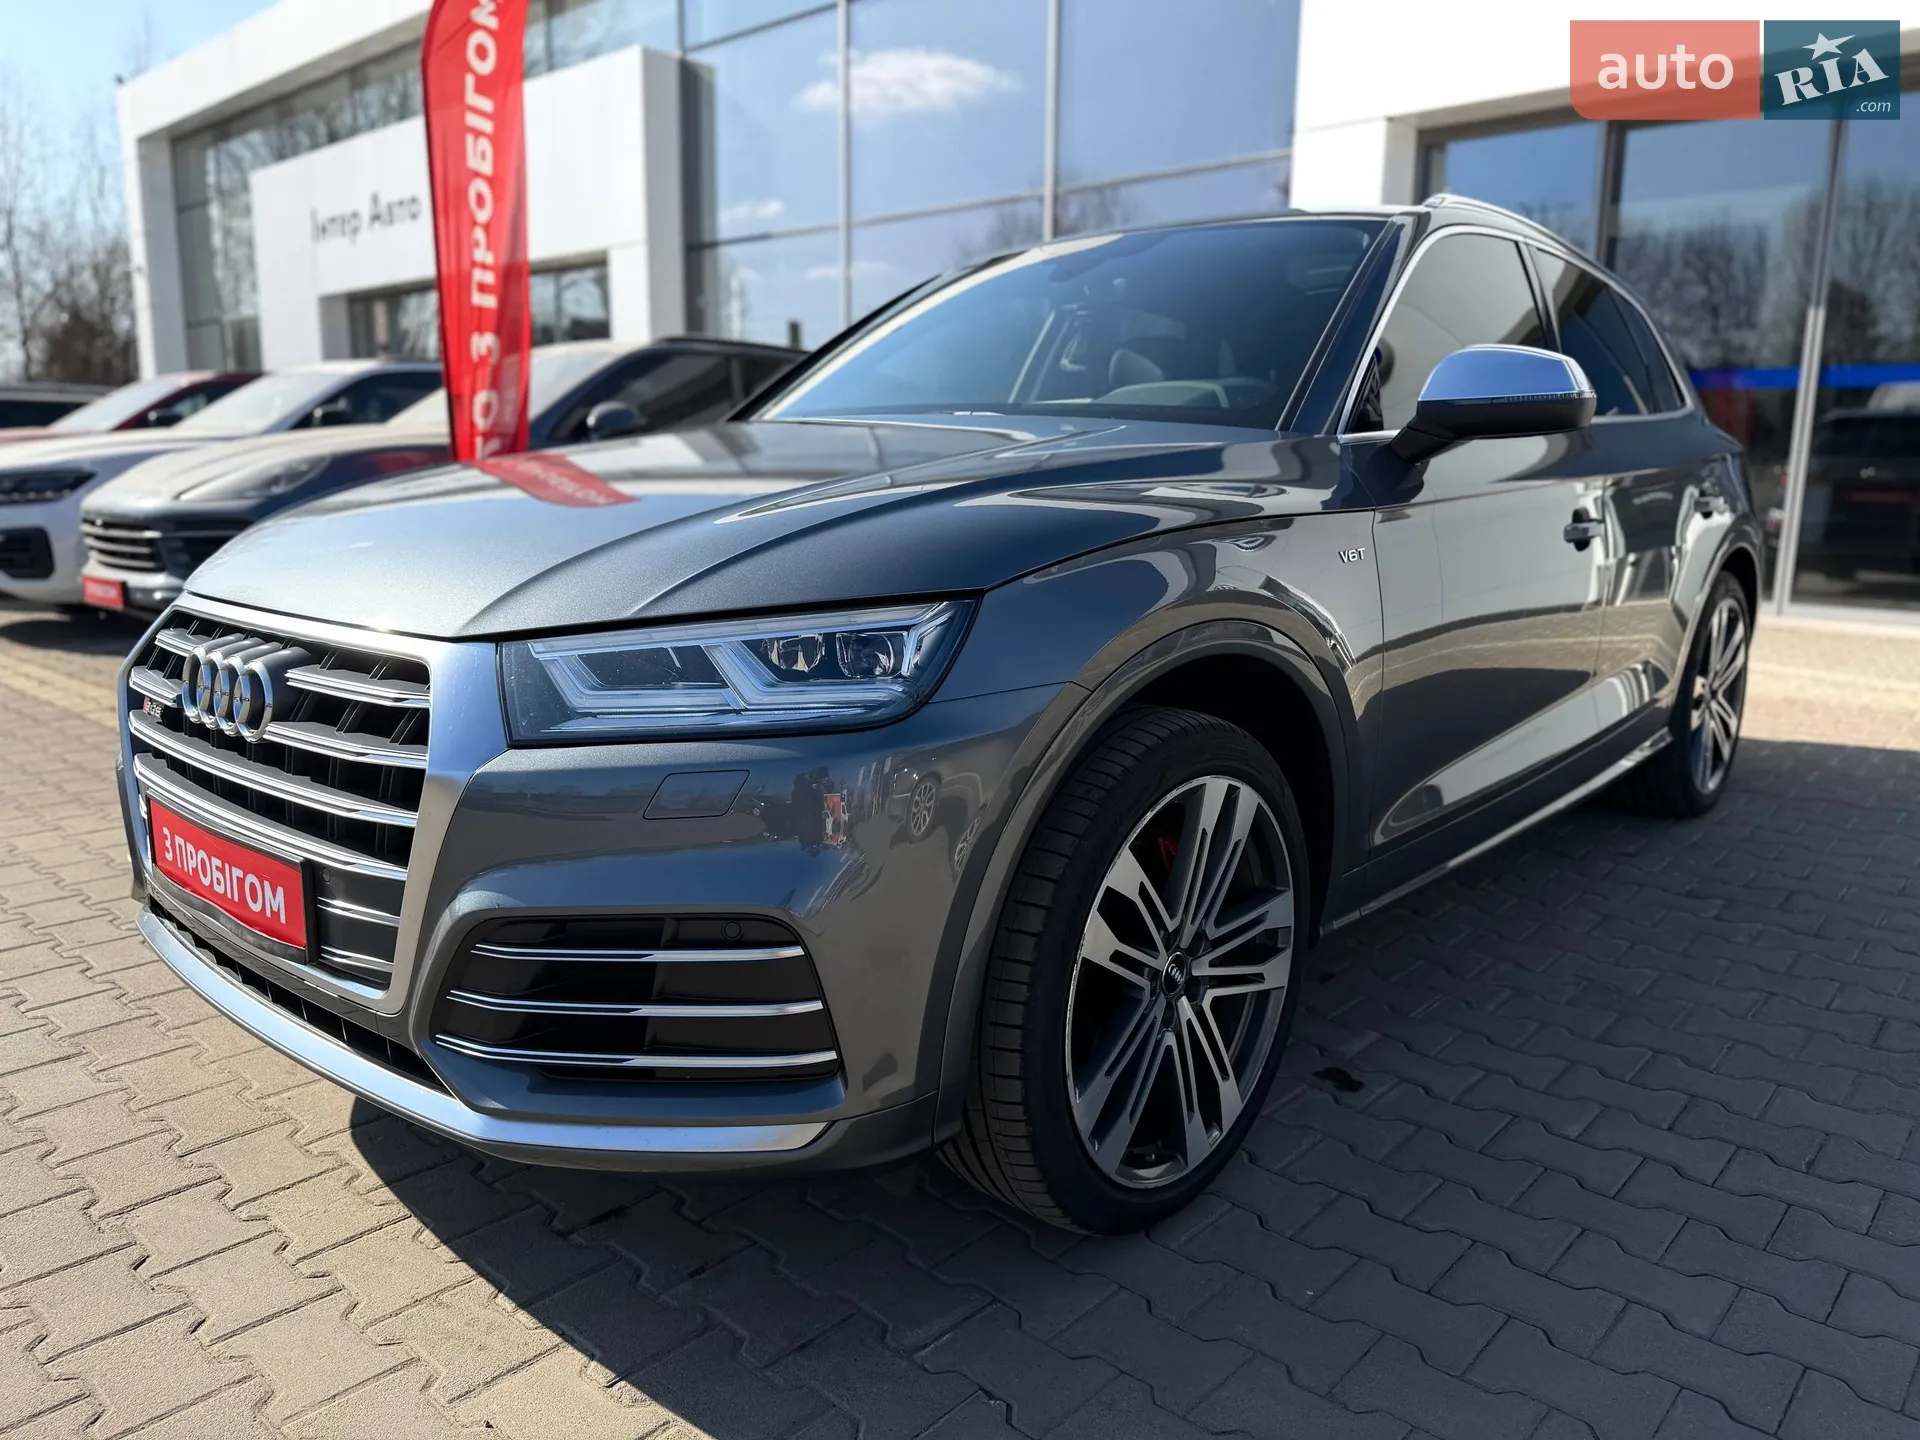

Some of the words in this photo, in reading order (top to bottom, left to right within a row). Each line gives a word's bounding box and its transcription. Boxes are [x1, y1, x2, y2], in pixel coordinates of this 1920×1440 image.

[367, 188, 422, 232] Авто
[1338, 547, 1366, 564] V6T
[174, 833, 286, 925] ПРОБІГОМ
